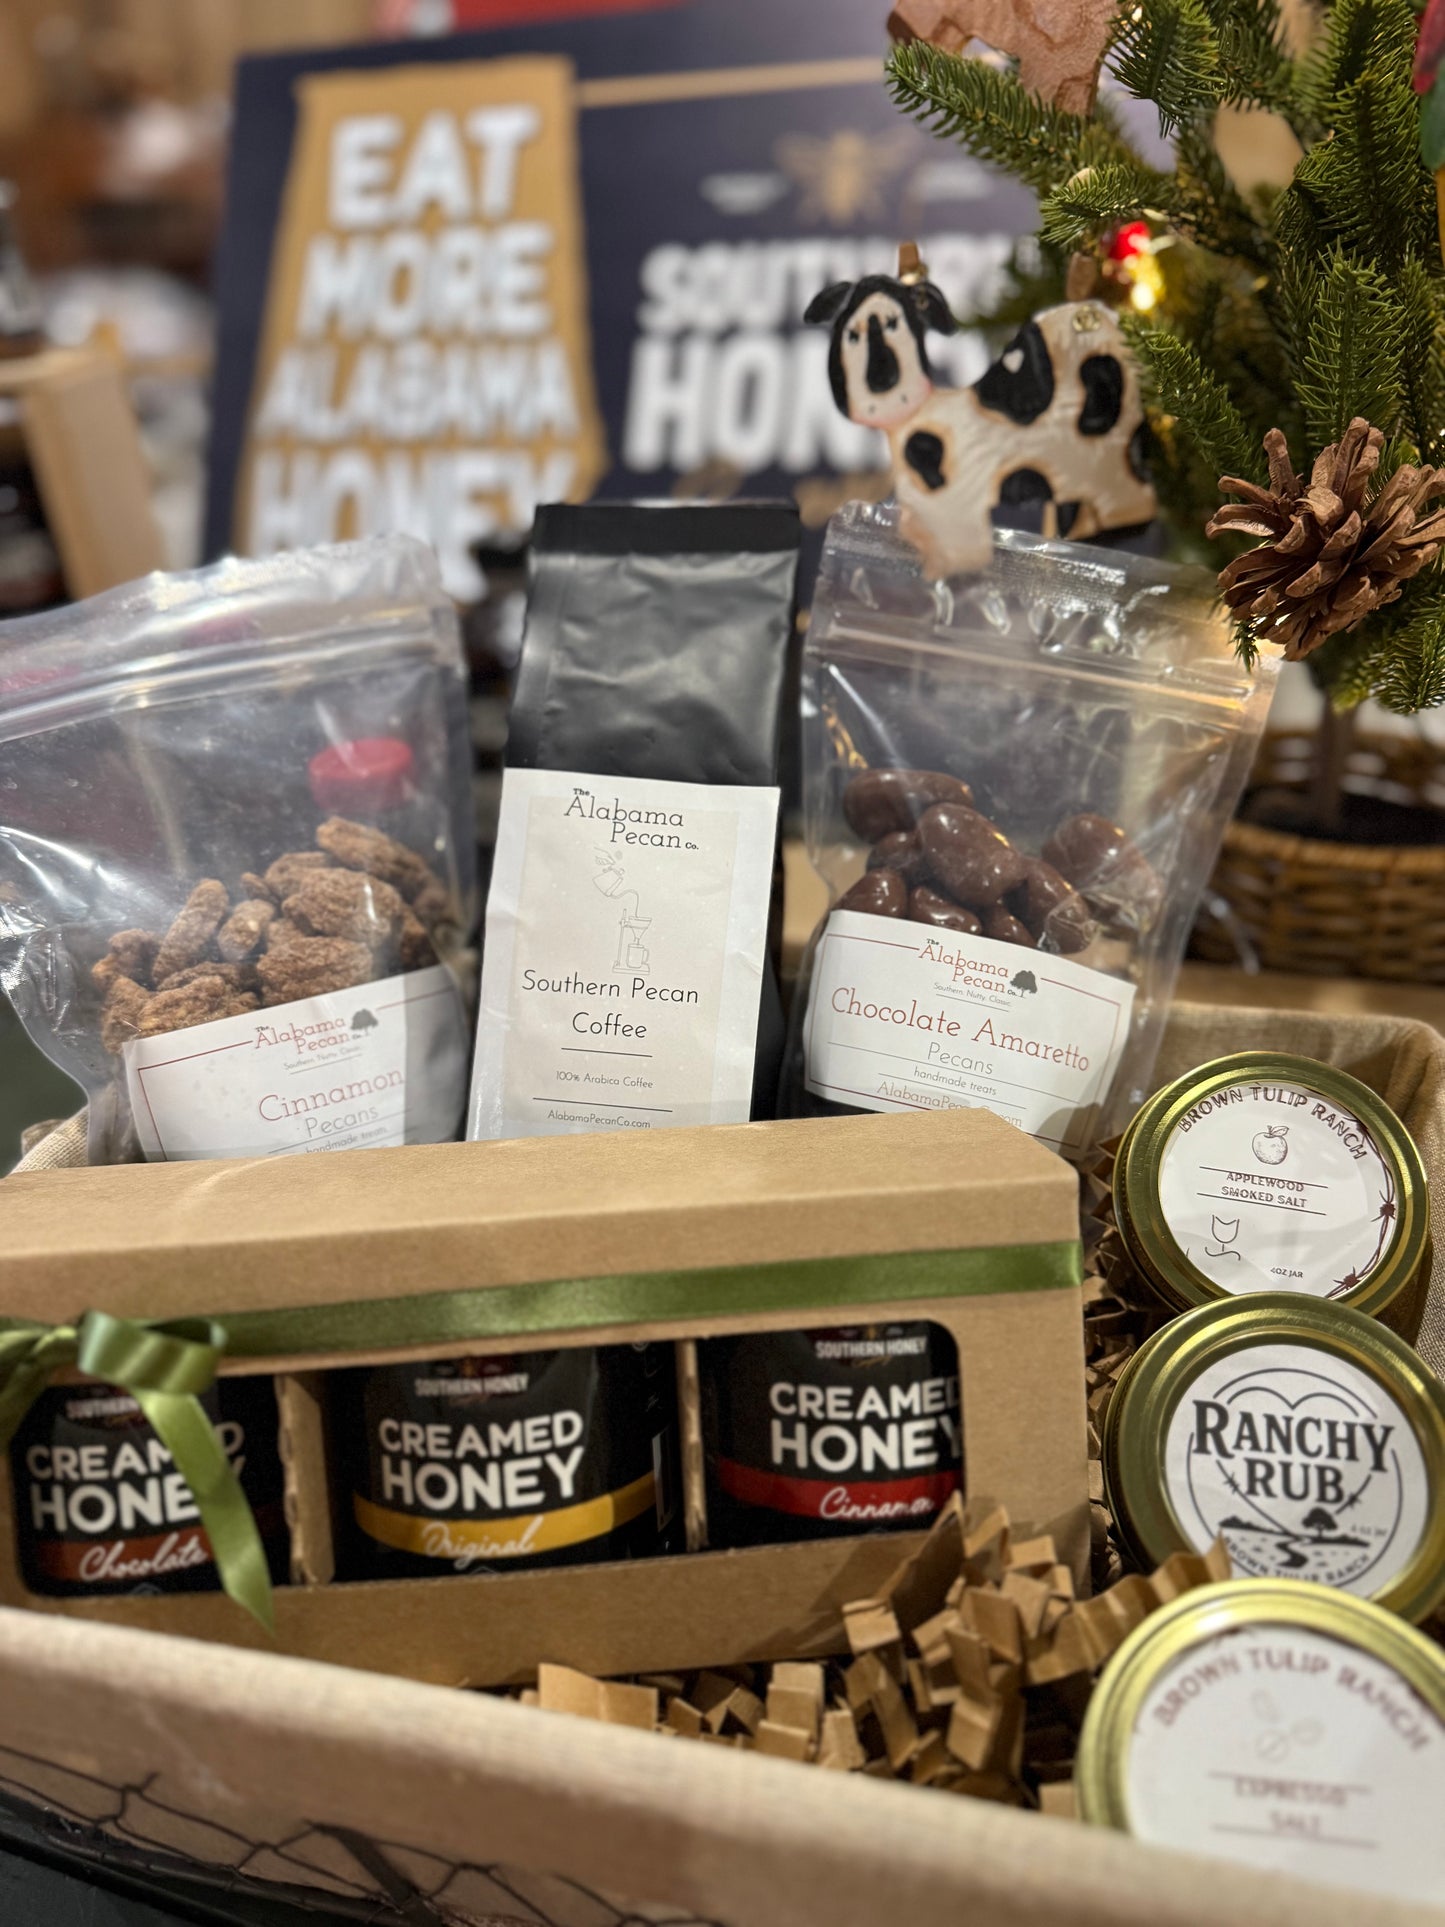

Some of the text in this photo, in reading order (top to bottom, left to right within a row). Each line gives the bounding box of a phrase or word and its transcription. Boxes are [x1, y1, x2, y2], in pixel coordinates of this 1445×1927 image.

[328, 105, 540, 229] EAT
[298, 222, 554, 340] MORE
[254, 338, 580, 442] ALABAMA
[573, 787, 590, 797] The
[563, 795, 684, 827] Alabama
[610, 821, 700, 850] Pecan Co.
[926, 938, 940, 946] The
[918, 944, 1009, 978] Alabama
[521, 969, 700, 1004] Southern Pecan
[952, 966, 1006, 994] Pecan
[255, 1017, 347, 1050] Alabama
[572, 1011, 648, 1039] Coffee
[831, 987, 1090, 1072] Chocolate Amaretto
[294, 1032, 350, 1055] Pecan
[927, 1041, 994, 1075] Pecans
[258, 1068, 405, 1122] Cinnamon
[556, 1070, 654, 1089] 100% Arabica Coffee
[913, 1065, 997, 1097] handmade treats
[304, 1105, 379, 1138] Pecans
[547, 1109, 651, 1129] AlabamaPecanCo.com
[1177, 1085, 1369, 1160] BROWN TULIP RANCH
[1220, 1185, 1308, 1209] SMOKED SALT
[1225, 1171, 1305, 1193] APPLEWOOD
[1288, 1269, 1304, 1279] JAR
[814, 1335, 928, 1359] SOUTHERN HONEY
[414, 1372, 531, 1397] SOUTHERN HONEY
[378, 1409, 585, 1459] CREAMED
[1191, 1398, 1395, 1473] RANCHY
[381, 1446, 585, 1512] HONEY
[1243, 1456, 1345, 1505] RUB
[818, 1485, 936, 1520] Cinnamon
[78, 1532, 207, 1582] Chocolate
[421, 1514, 545, 1572] Original
[1153, 1646, 1431, 1752] BROWN TULIP RANCH
